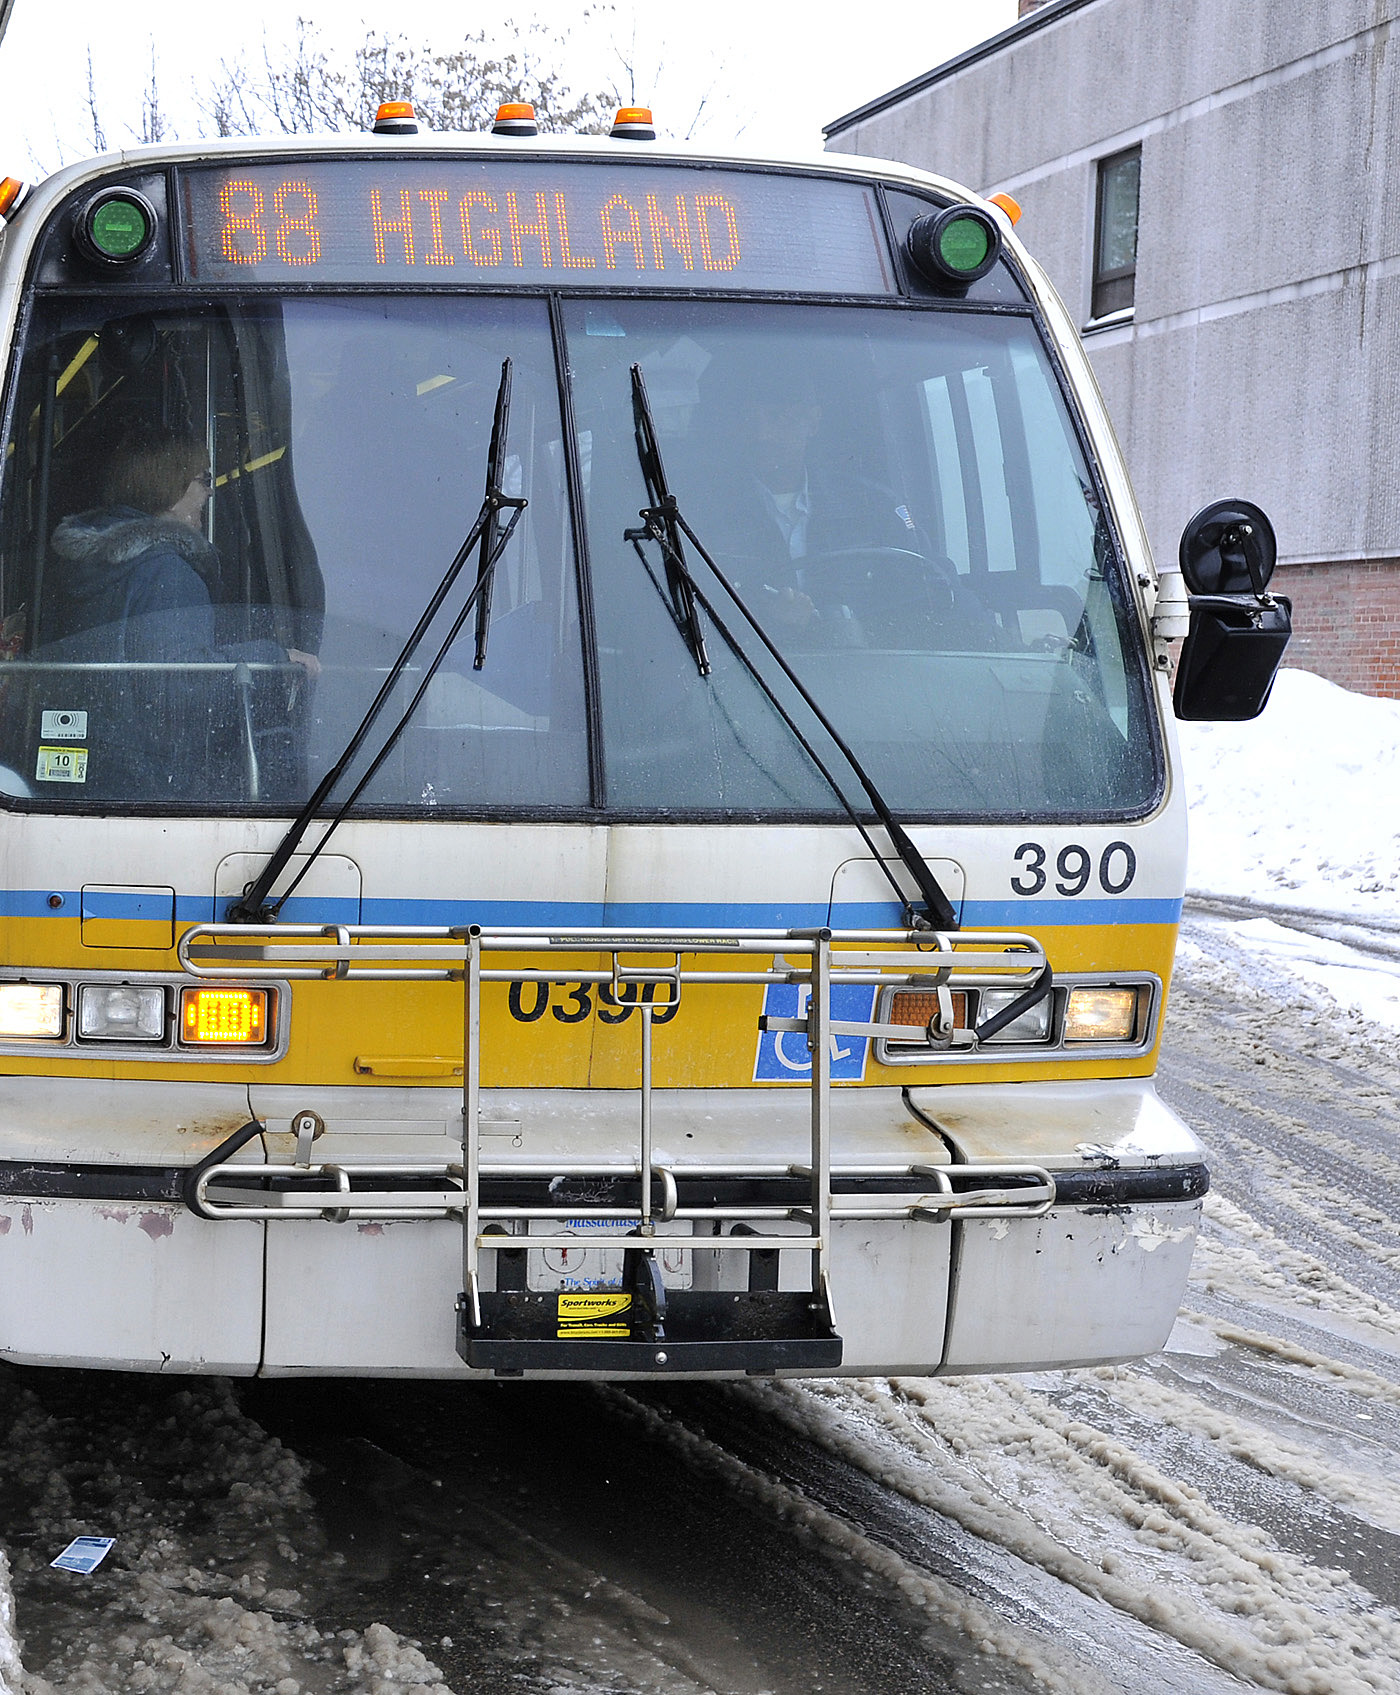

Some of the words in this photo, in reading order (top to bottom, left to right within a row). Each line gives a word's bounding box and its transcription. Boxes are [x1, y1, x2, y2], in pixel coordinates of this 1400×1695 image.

[219, 181, 322, 266] 88
[370, 189, 741, 272] HIGHLAND
[54, 755, 70, 767] 10
[1010, 841, 1137, 897] 390
[508, 967, 681, 1025] 0390
[565, 1277, 580, 1286] The
[561, 1298, 617, 1308] Sportworks
